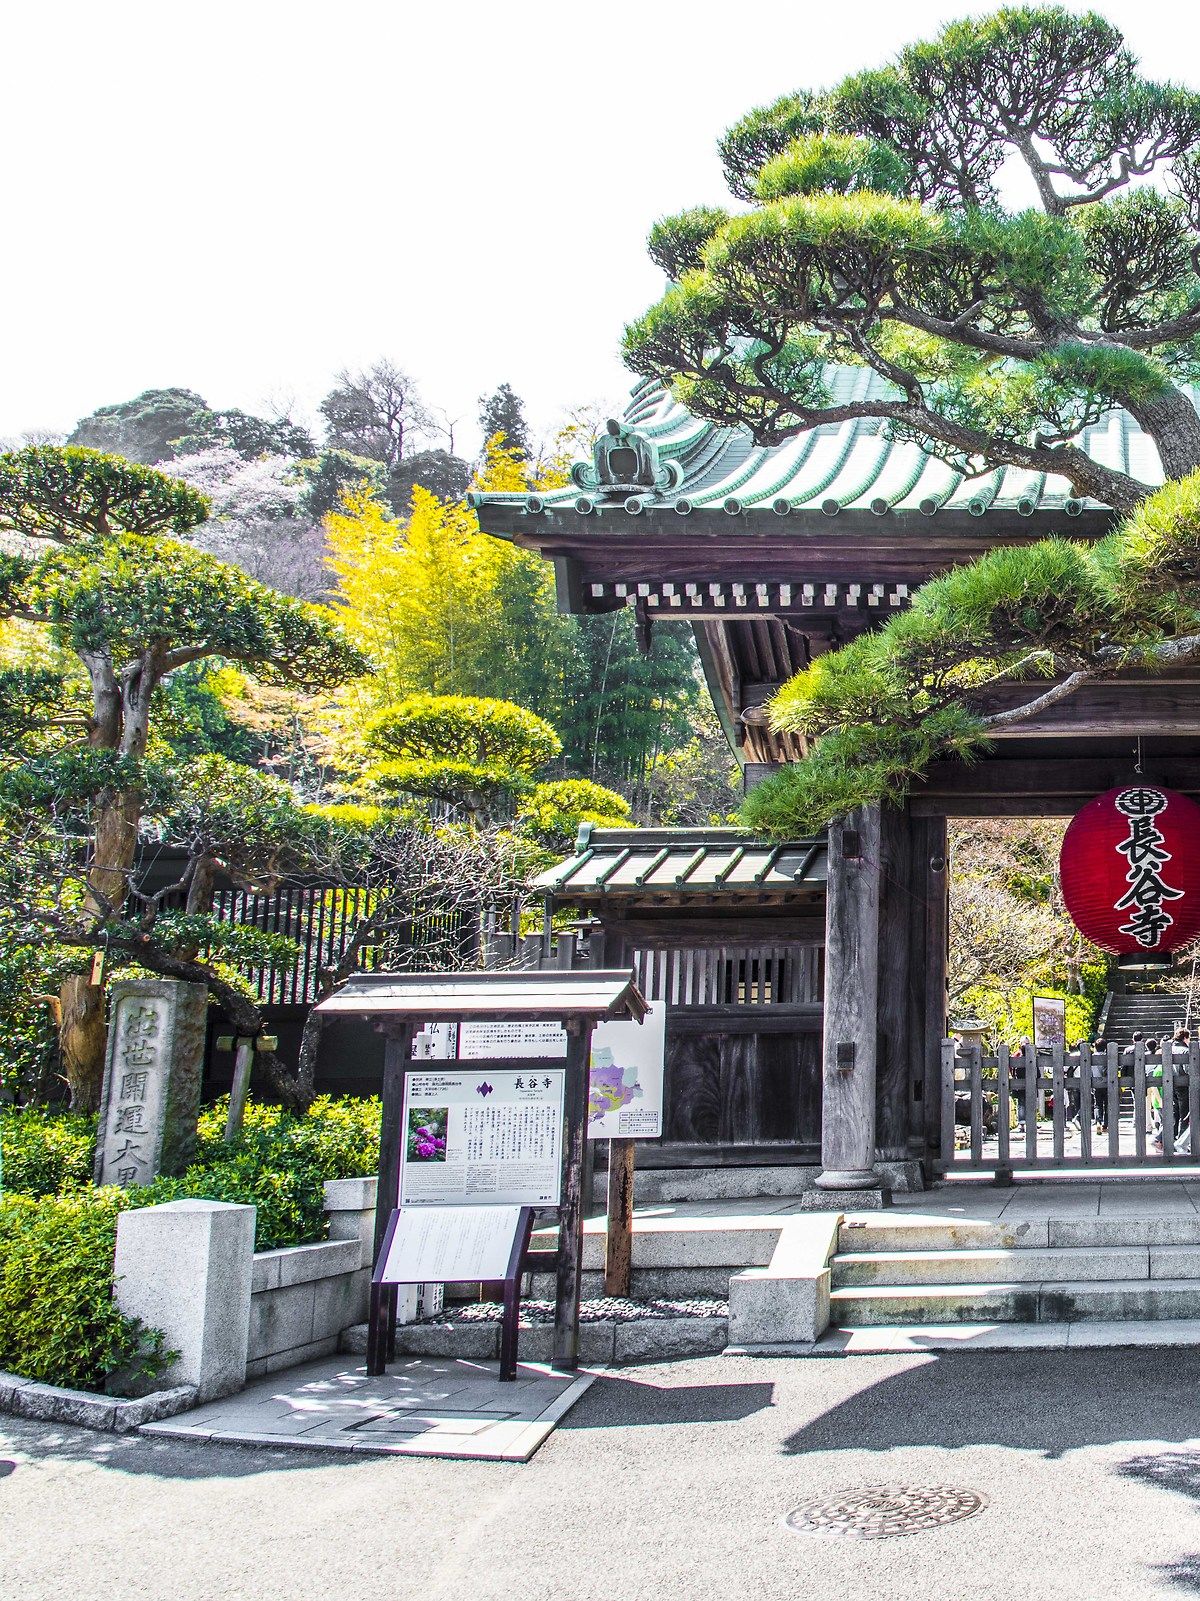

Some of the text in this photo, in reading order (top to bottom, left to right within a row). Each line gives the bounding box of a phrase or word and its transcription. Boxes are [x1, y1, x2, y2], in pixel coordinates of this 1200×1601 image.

[1114, 814, 1184, 946] 長谷寺
[514, 1077, 553, 1090] 長谷寺
